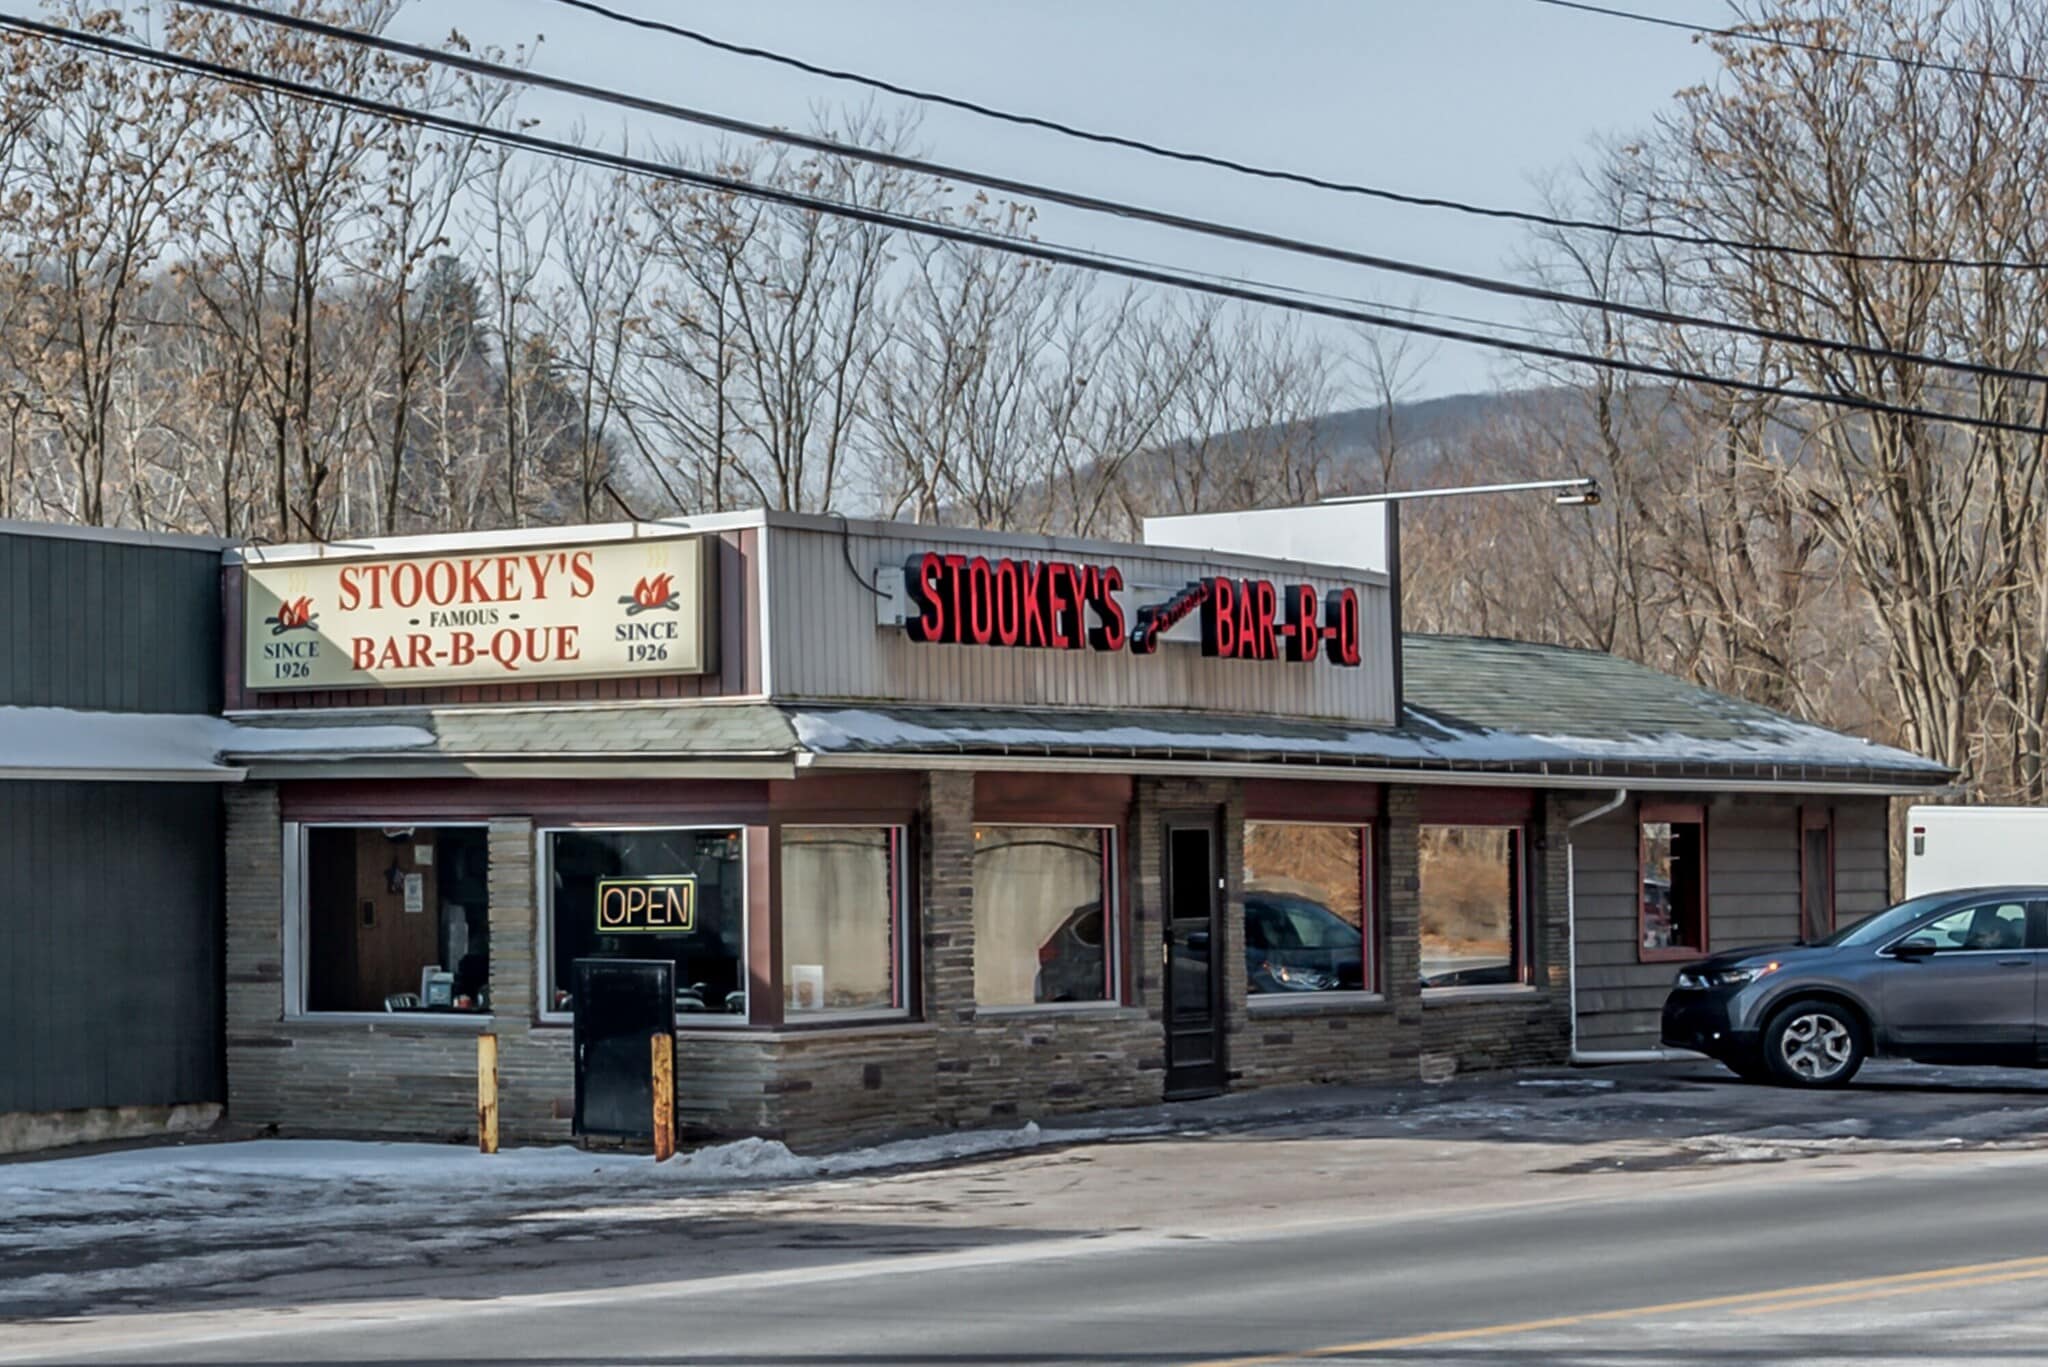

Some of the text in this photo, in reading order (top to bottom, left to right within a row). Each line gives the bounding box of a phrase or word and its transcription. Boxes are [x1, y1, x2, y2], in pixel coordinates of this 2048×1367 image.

[338, 551, 595, 612] STOOKEY'S
[429, 608, 500, 628] FAMOUS
[906, 551, 1125, 651] STOOKEY'S
[1201, 576, 1361, 667] BAR-B-Q
[614, 621, 679, 642] SINCE
[263, 641, 320, 659] SINCE
[351, 625, 580, 671] BAR-B-QUE
[626, 643, 669, 663] 1926
[273, 660, 311, 679] 1926
[602, 886, 689, 924] OPEN
